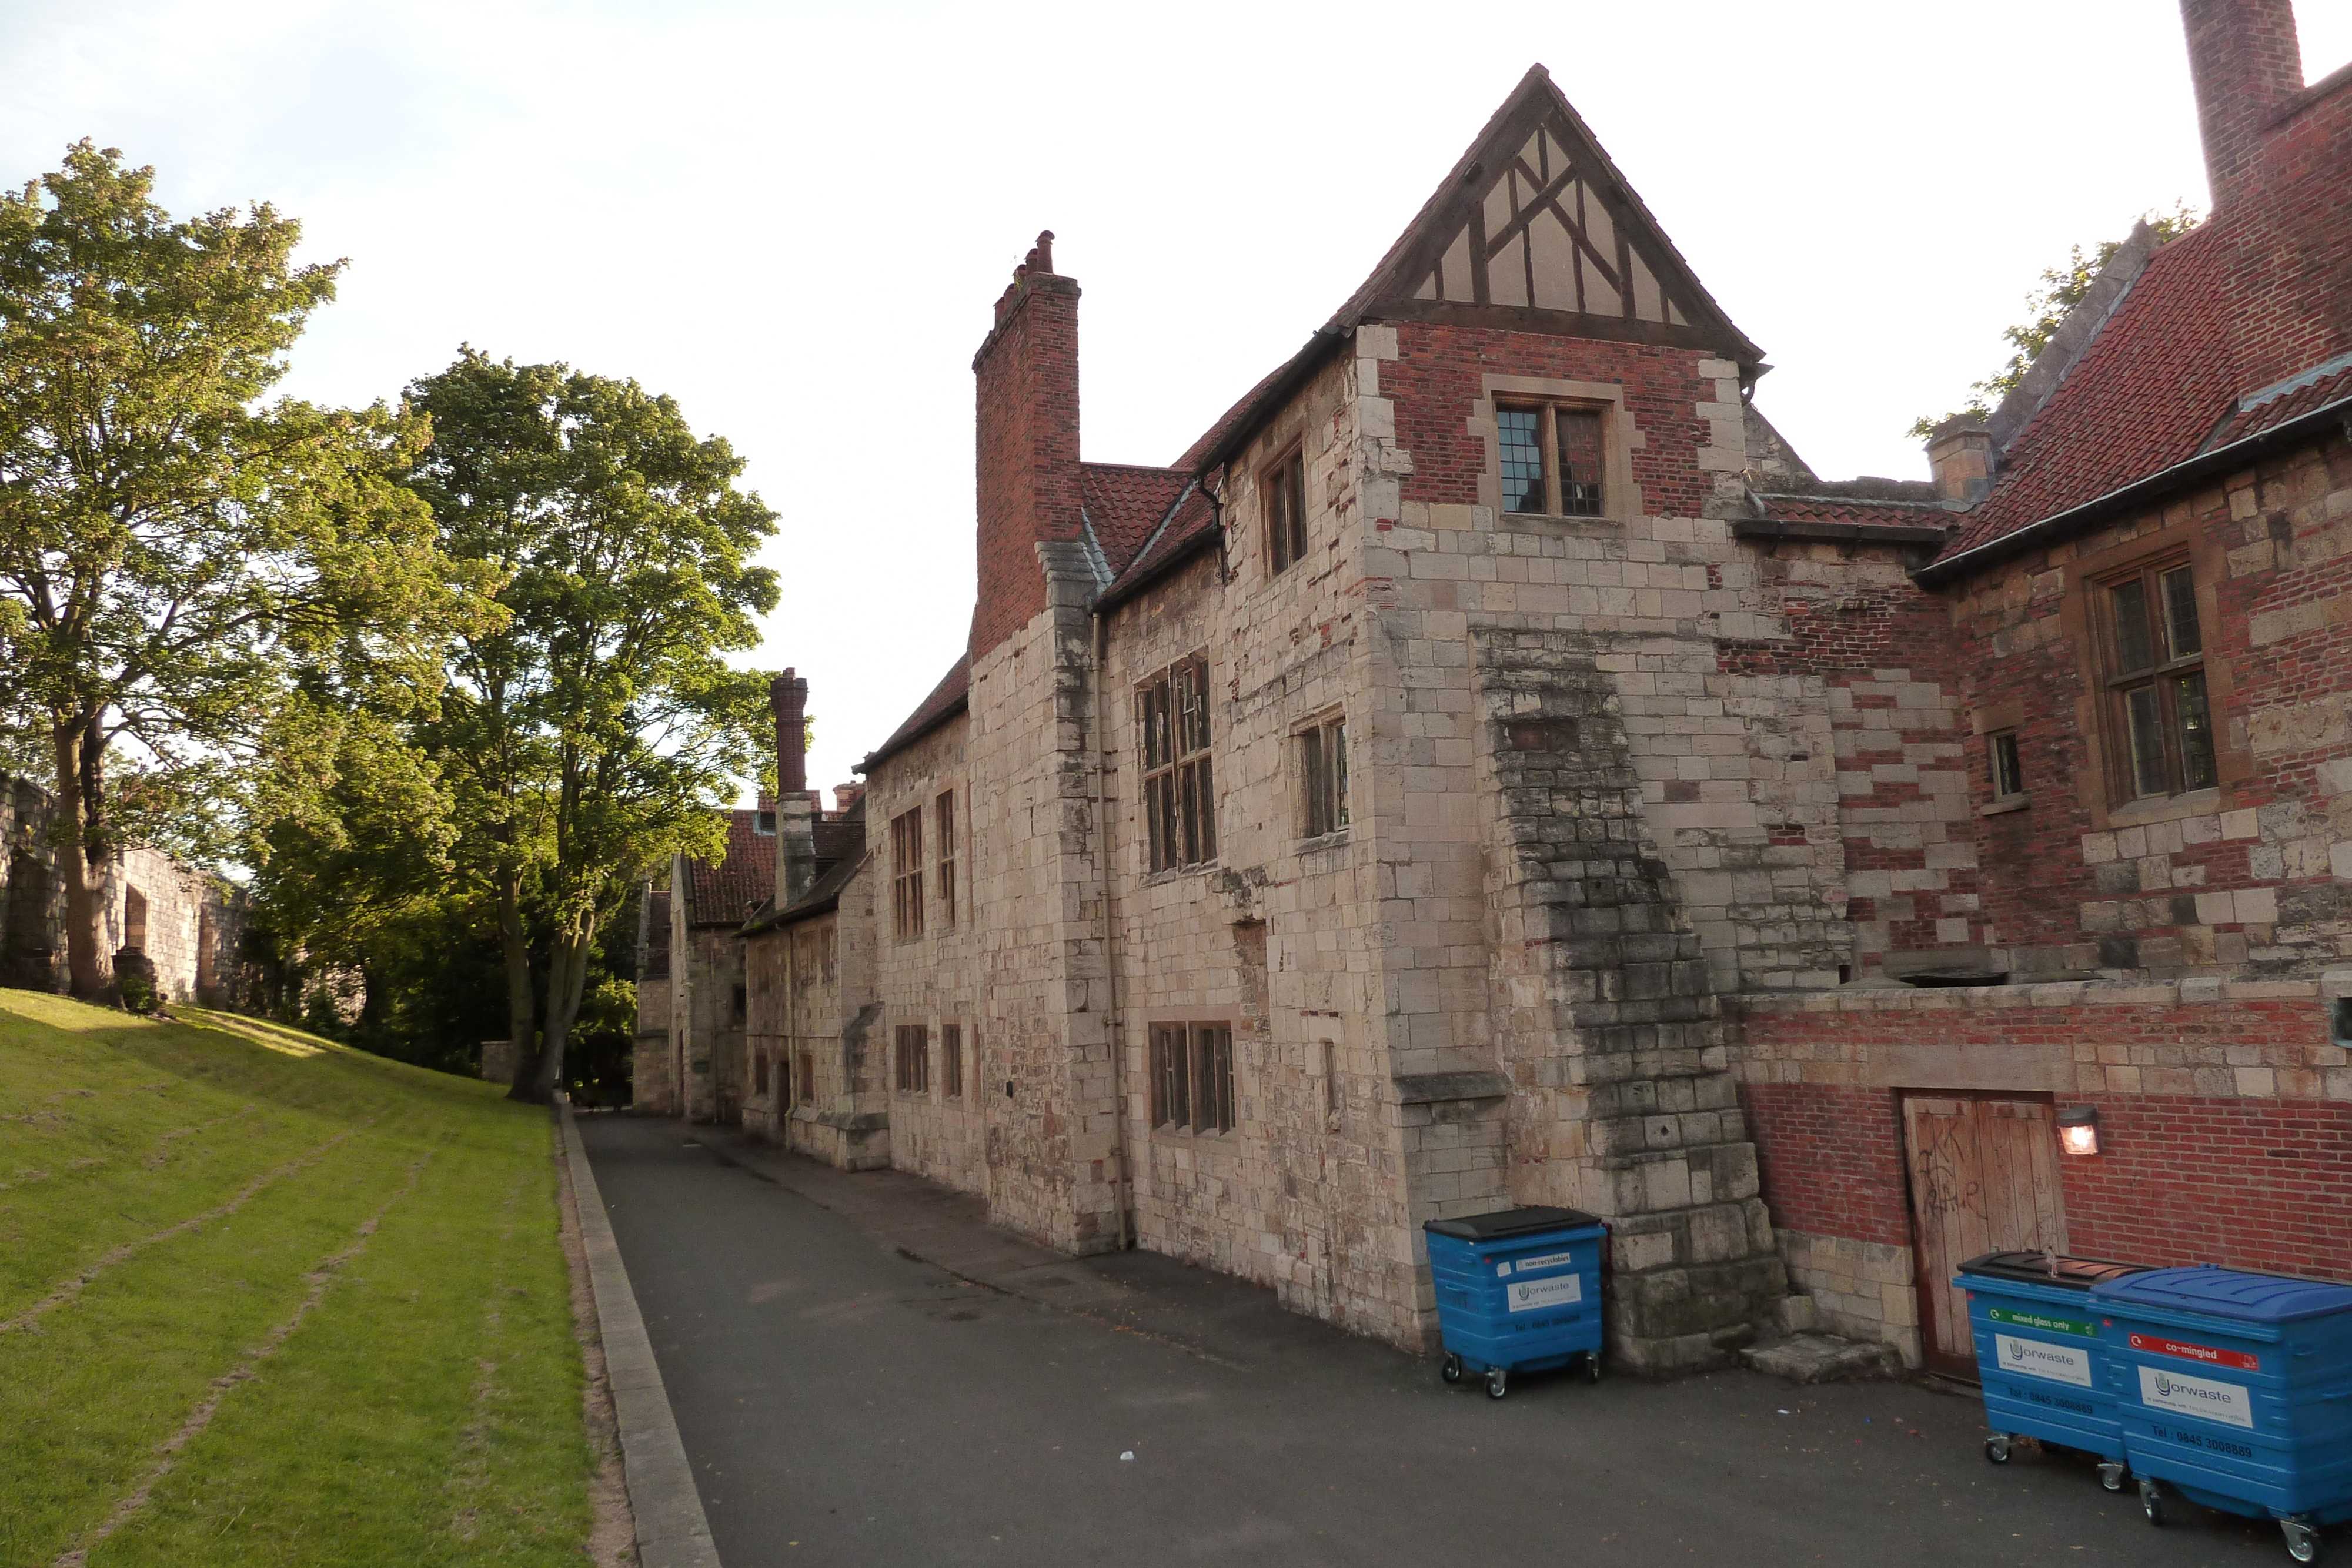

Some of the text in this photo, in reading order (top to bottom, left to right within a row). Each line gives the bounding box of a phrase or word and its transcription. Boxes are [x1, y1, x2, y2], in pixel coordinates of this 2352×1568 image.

[2012, 1313, 2069, 1331] mixed glass only
[2166, 1342, 2217, 1359] co-mingled
[2030, 1392, 2051, 1405] 0845
[2177, 1431, 2202, 1447] 0845
